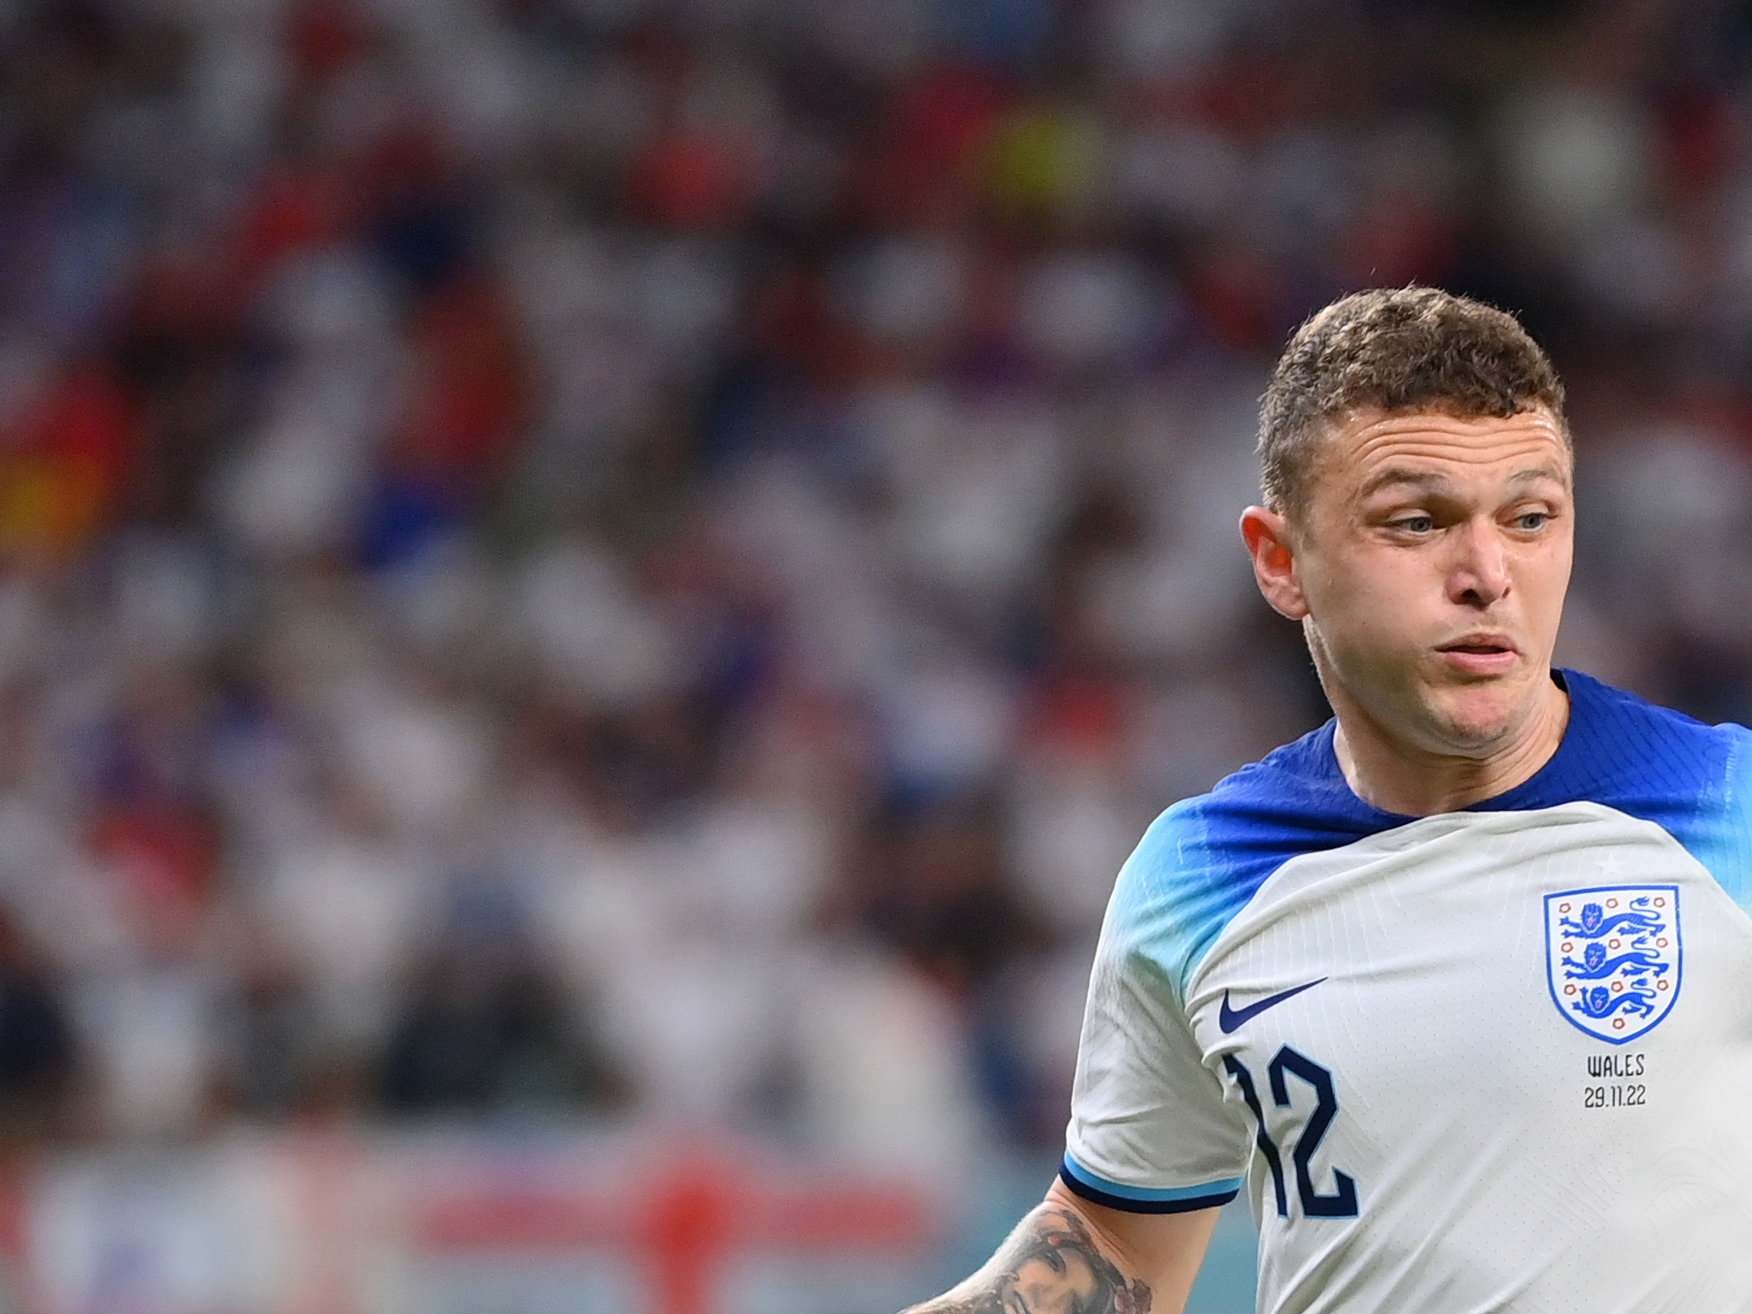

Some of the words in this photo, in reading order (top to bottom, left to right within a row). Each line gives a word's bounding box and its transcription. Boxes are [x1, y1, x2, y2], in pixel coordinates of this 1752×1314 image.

[1587, 1054, 1645, 1078] WALES
[1584, 1084, 1646, 1108] 29.11.22
[1221, 1043, 1359, 1220] 12
